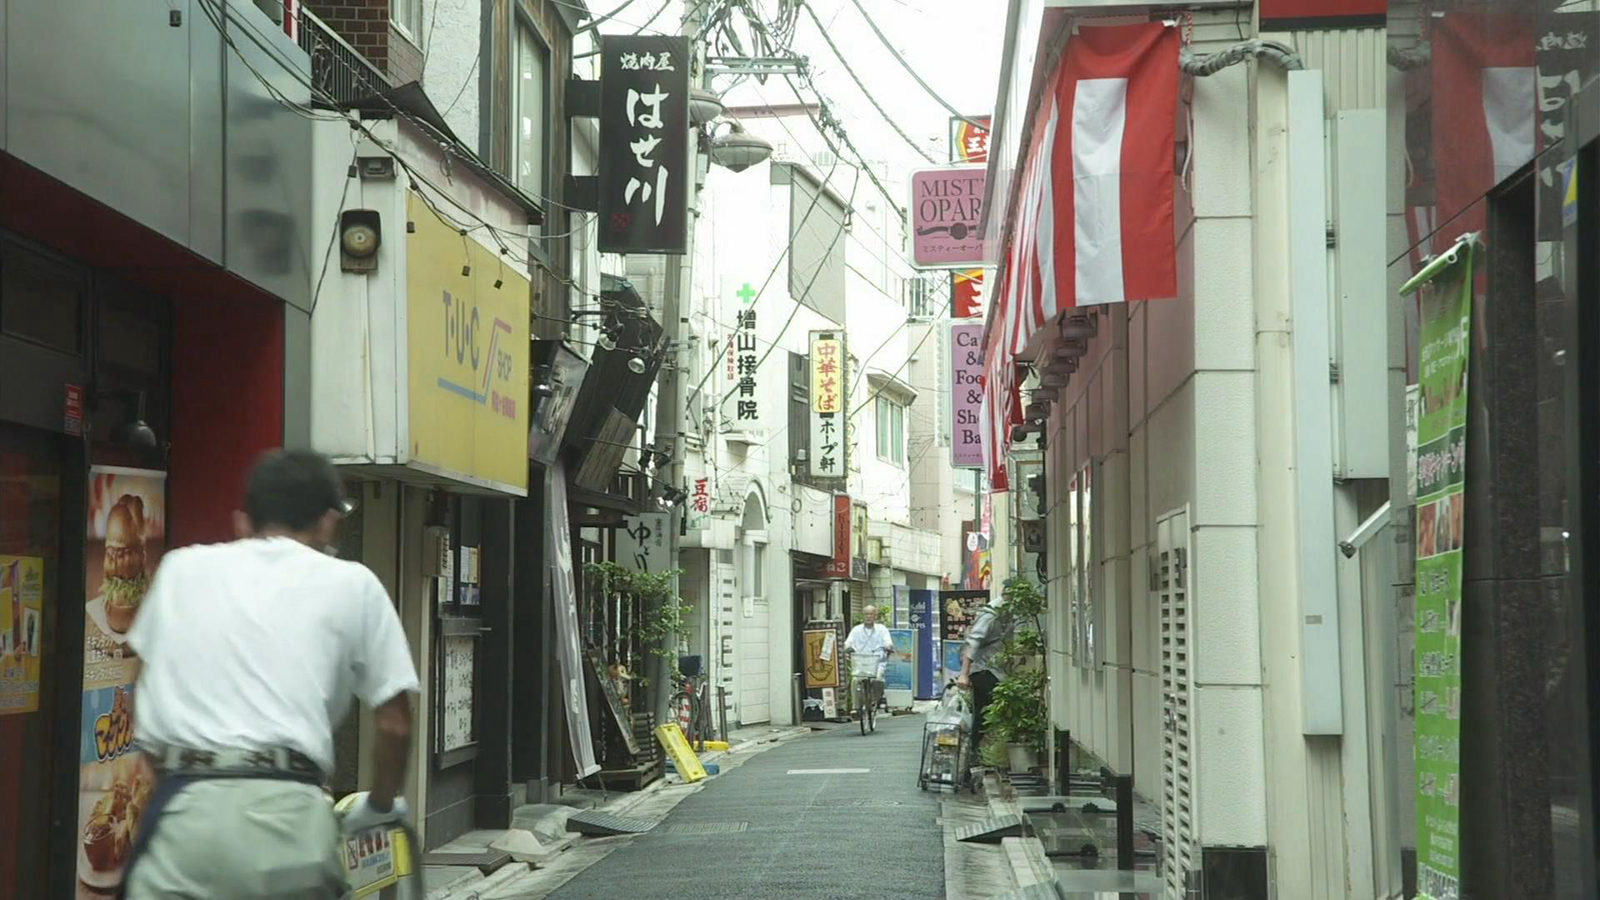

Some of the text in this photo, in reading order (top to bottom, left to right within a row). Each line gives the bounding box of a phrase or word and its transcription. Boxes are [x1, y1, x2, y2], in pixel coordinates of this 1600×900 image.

[620, 52, 675, 72] 焼肉屋
[624, 83, 670, 227] はせ川
[921, 178, 984, 198] MIST
[957, 331, 979, 347] Ca
[737, 309, 759, 420] 増山接骨院
[966, 351, 977, 366] &
[817, 342, 837, 411] 中華そば
[966, 390, 982, 404] &
[957, 410, 980, 424] Sh
[818, 420, 838, 474] ホープ軒
